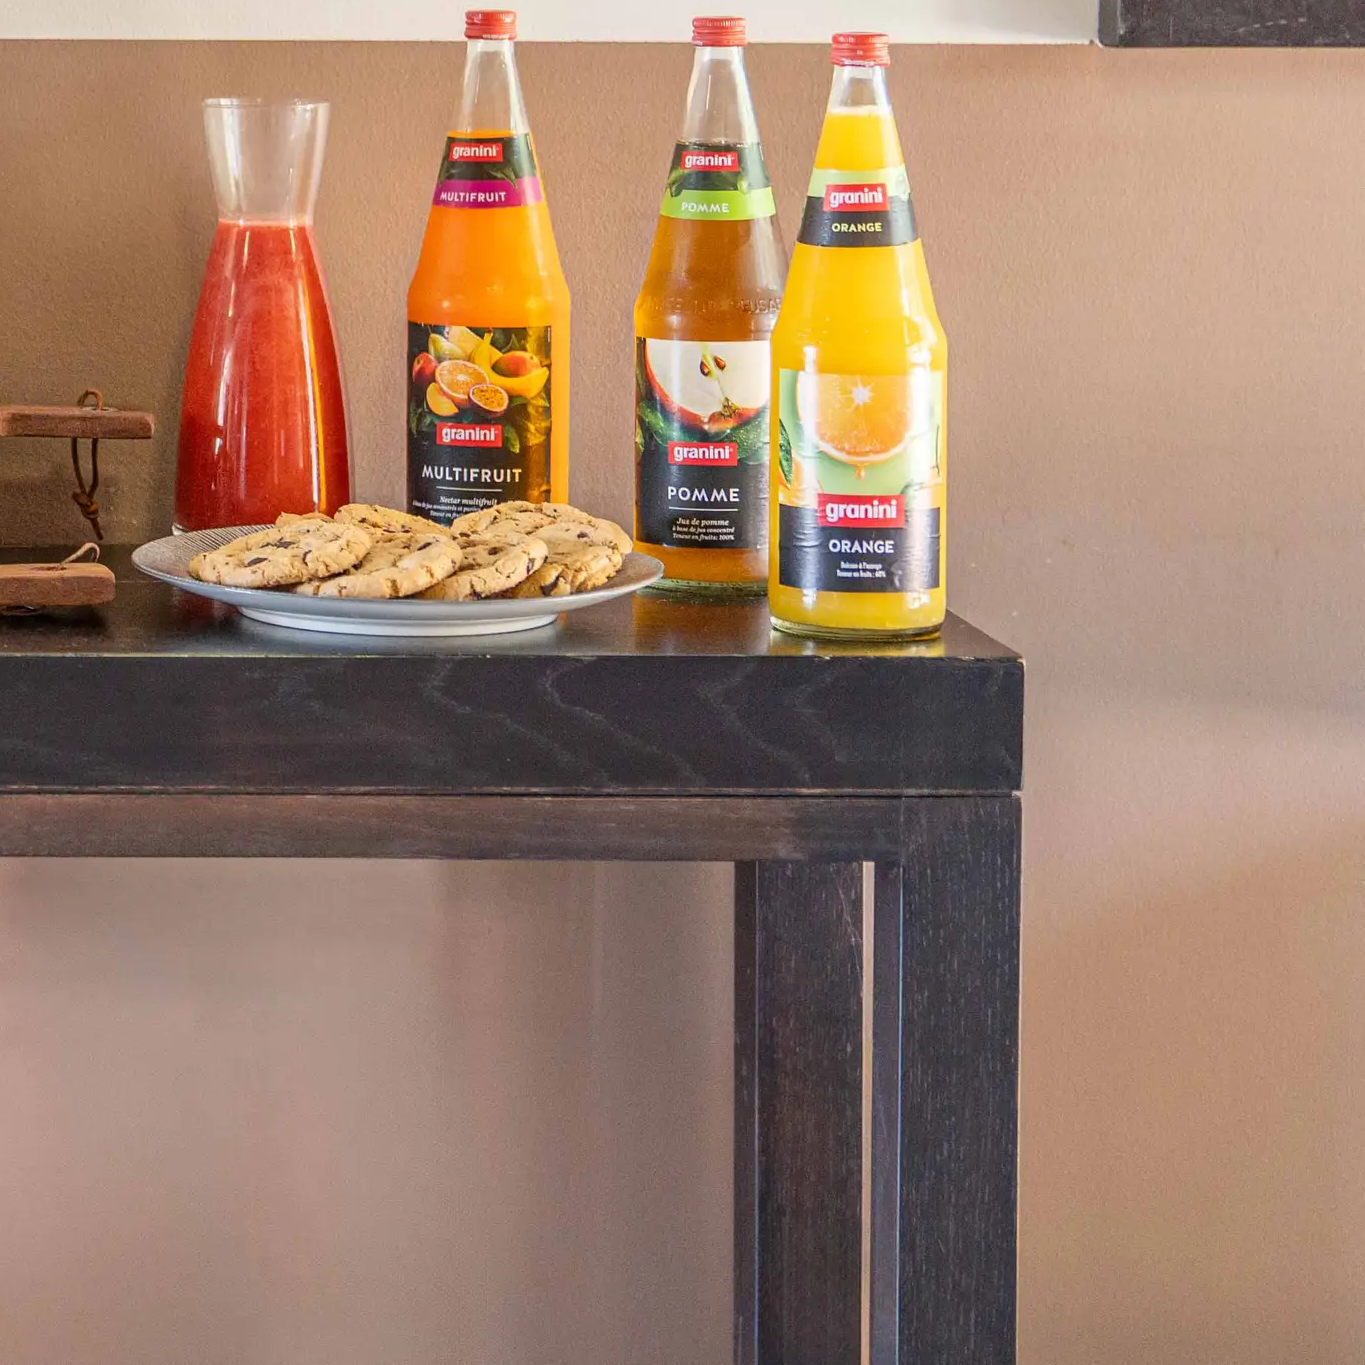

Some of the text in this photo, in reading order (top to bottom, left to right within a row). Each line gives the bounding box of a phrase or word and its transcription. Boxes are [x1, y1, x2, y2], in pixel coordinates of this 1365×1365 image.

[453, 145, 497, 159] granini
[685, 155, 732, 168] granini
[440, 192, 507, 203] MULTIFRUIT
[830, 187, 883, 208] granini
[681, 202, 730, 213] POMME
[832, 223, 883, 232] ORANGE
[442, 427, 495, 442] granini
[674, 446, 730, 462] granini
[422, 465, 522, 483] MULTIFRUIT
[667, 486, 740, 502] POMME
[440, 496, 497, 507] Nectar multifruit
[826, 499, 897, 523] granini
[677, 518, 730, 528] Jus de pomme
[829, 539, 895, 554] ORANGE
